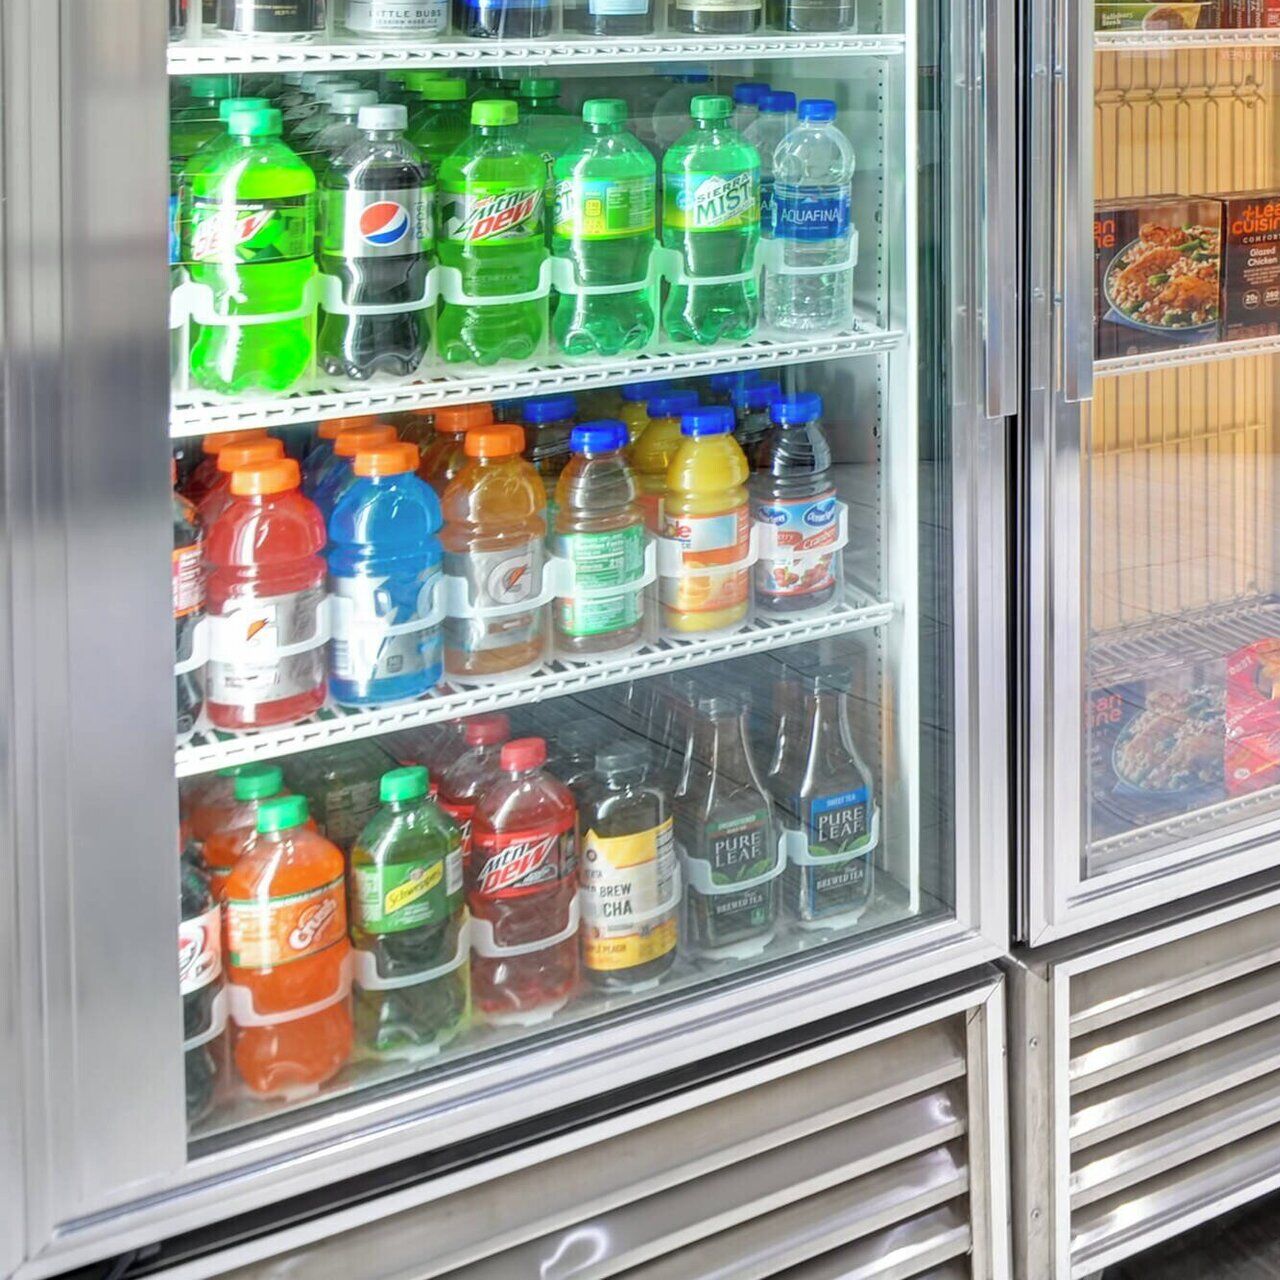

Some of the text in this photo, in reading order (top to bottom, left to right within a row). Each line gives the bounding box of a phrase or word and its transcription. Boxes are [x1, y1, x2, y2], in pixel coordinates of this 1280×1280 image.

[696, 172, 751, 202] SIERRA
[696, 179, 753, 223] MIST
[780, 207, 841, 222] AQUAFINA
[1247, 257, 1278, 266] Chicken
[1249, 247, 1276, 257] Glazed
[818, 807, 864, 830] PURE
[818, 822, 865, 843] LEAF
[715, 831, 762, 856] PURE
[715, 846, 762, 868] LEAF
[600, 883, 632, 898] BREW
[817, 873, 849, 890] BREWED
